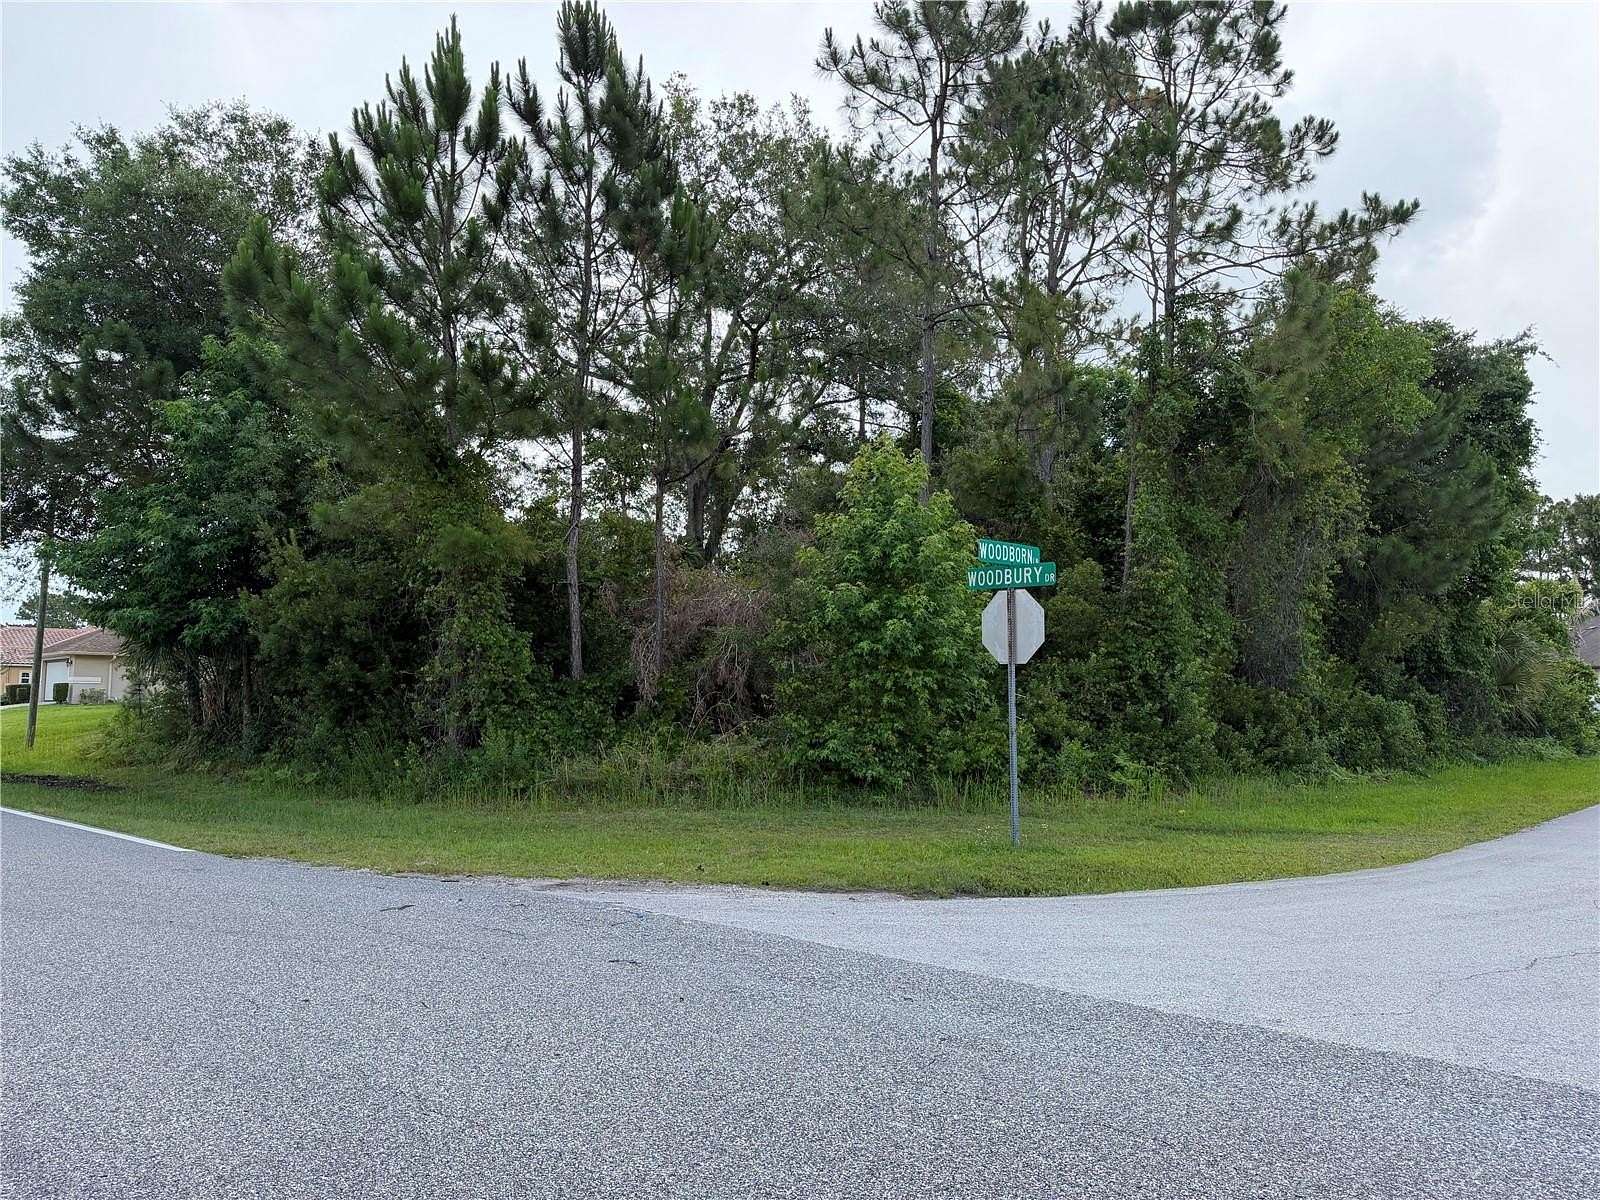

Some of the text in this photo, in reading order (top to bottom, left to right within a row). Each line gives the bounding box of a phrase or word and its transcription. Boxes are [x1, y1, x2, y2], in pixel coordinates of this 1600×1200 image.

[979, 542, 1033, 564] WOODBORN
[968, 566, 1056, 587] WOODBURY DR
